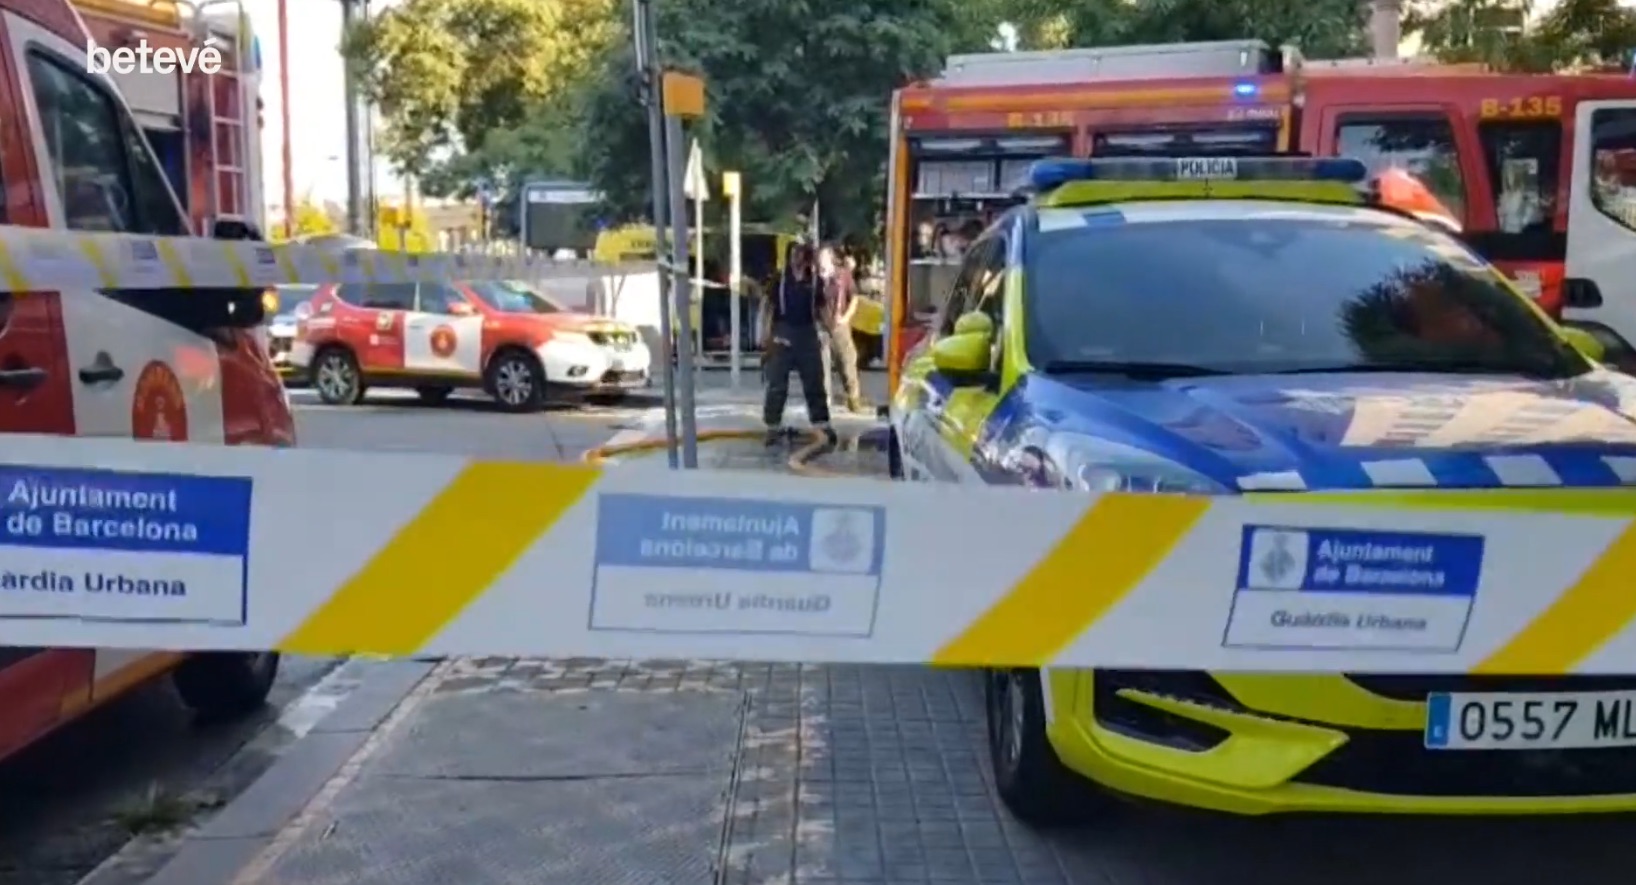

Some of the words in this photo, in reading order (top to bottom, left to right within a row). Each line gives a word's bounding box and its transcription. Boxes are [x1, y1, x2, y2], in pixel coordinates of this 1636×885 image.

[1481, 96, 1562, 118] B-135
[8, 479, 177, 512] Ajuntament
[6, 513, 42, 535] de
[53, 511, 198, 541] Barcelona
[1316, 539, 1433, 565] Ajuntament
[84, 572, 186, 596] Urbana
[1356, 612, 1427, 630] Urbana
[1460, 701, 1578, 741] 0557
[1594, 699, 1636, 740] ML
